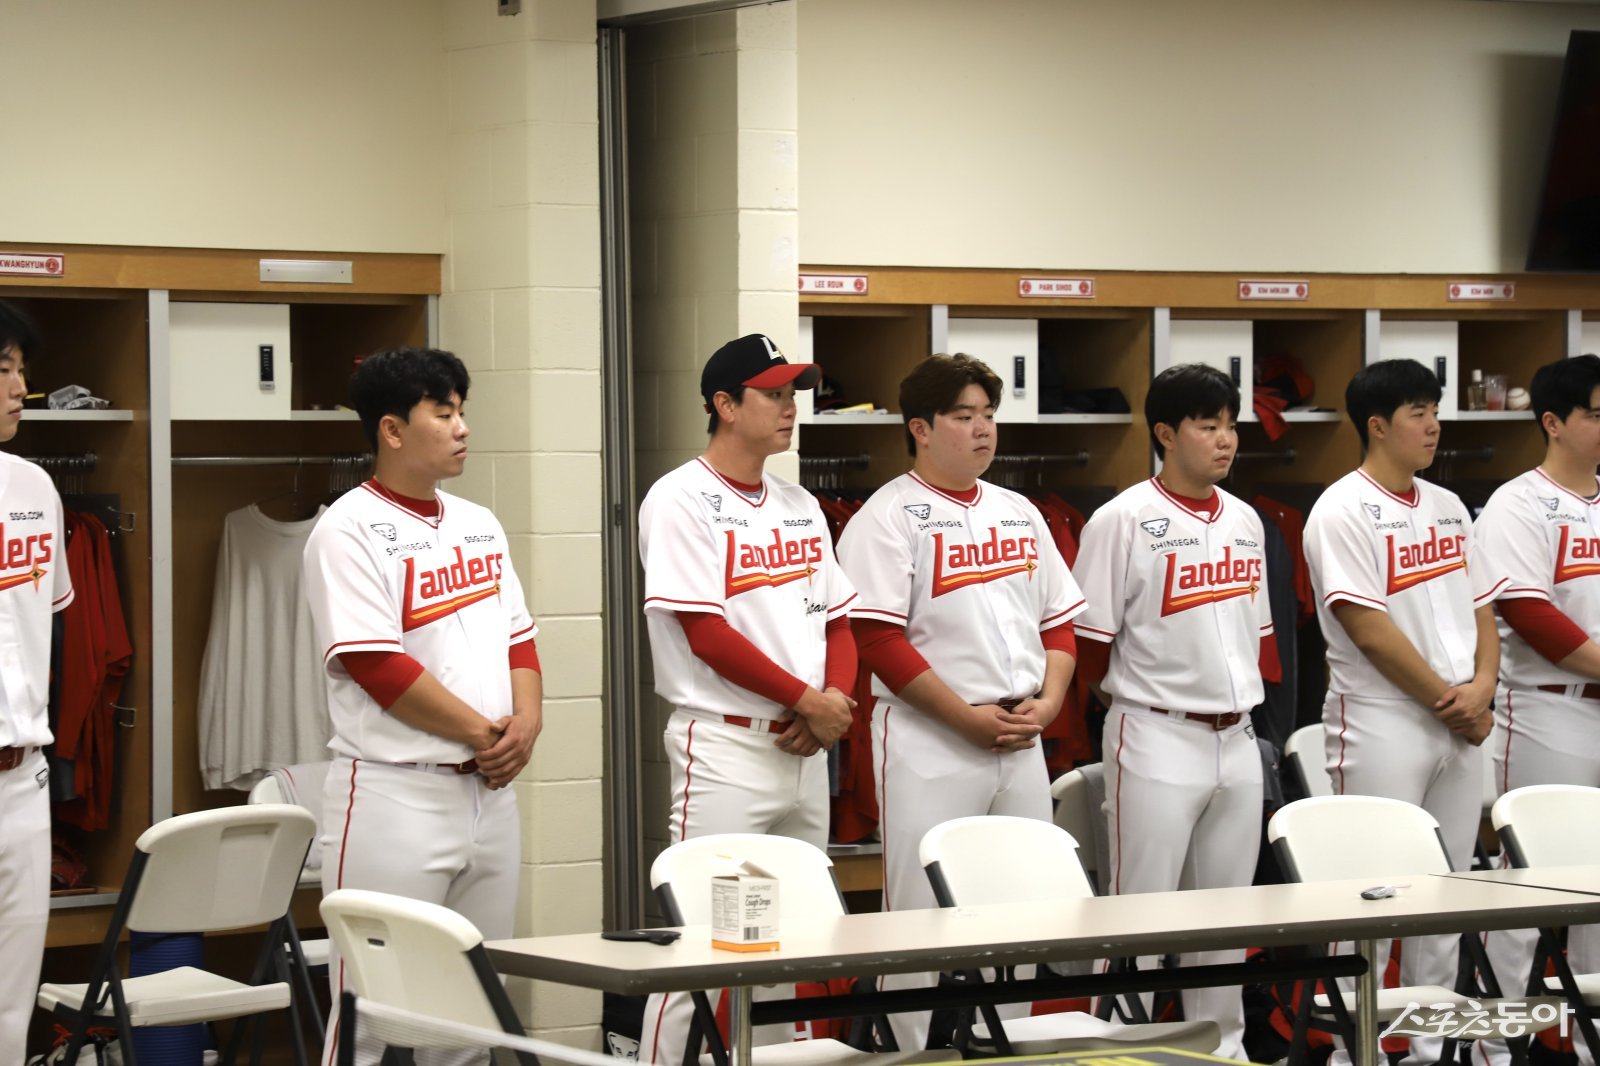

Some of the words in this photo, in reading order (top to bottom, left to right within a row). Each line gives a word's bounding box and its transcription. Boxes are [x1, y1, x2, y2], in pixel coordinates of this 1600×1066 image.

[815, 280, 825, 288] LEE
[9, 511, 44, 520] SSG.COM
[386, 541, 433, 556] SHINSEGAE
[724, 528, 822, 600] Landers
[931, 527, 1039, 599] Landers
[1150, 538, 1200, 551] SHINSEGAE
[1385, 526, 1467, 596] Lander
[402, 546, 503, 633] Landers
[1161, 546, 1262, 617] Landers
[745, 898, 759, 908] Cough
